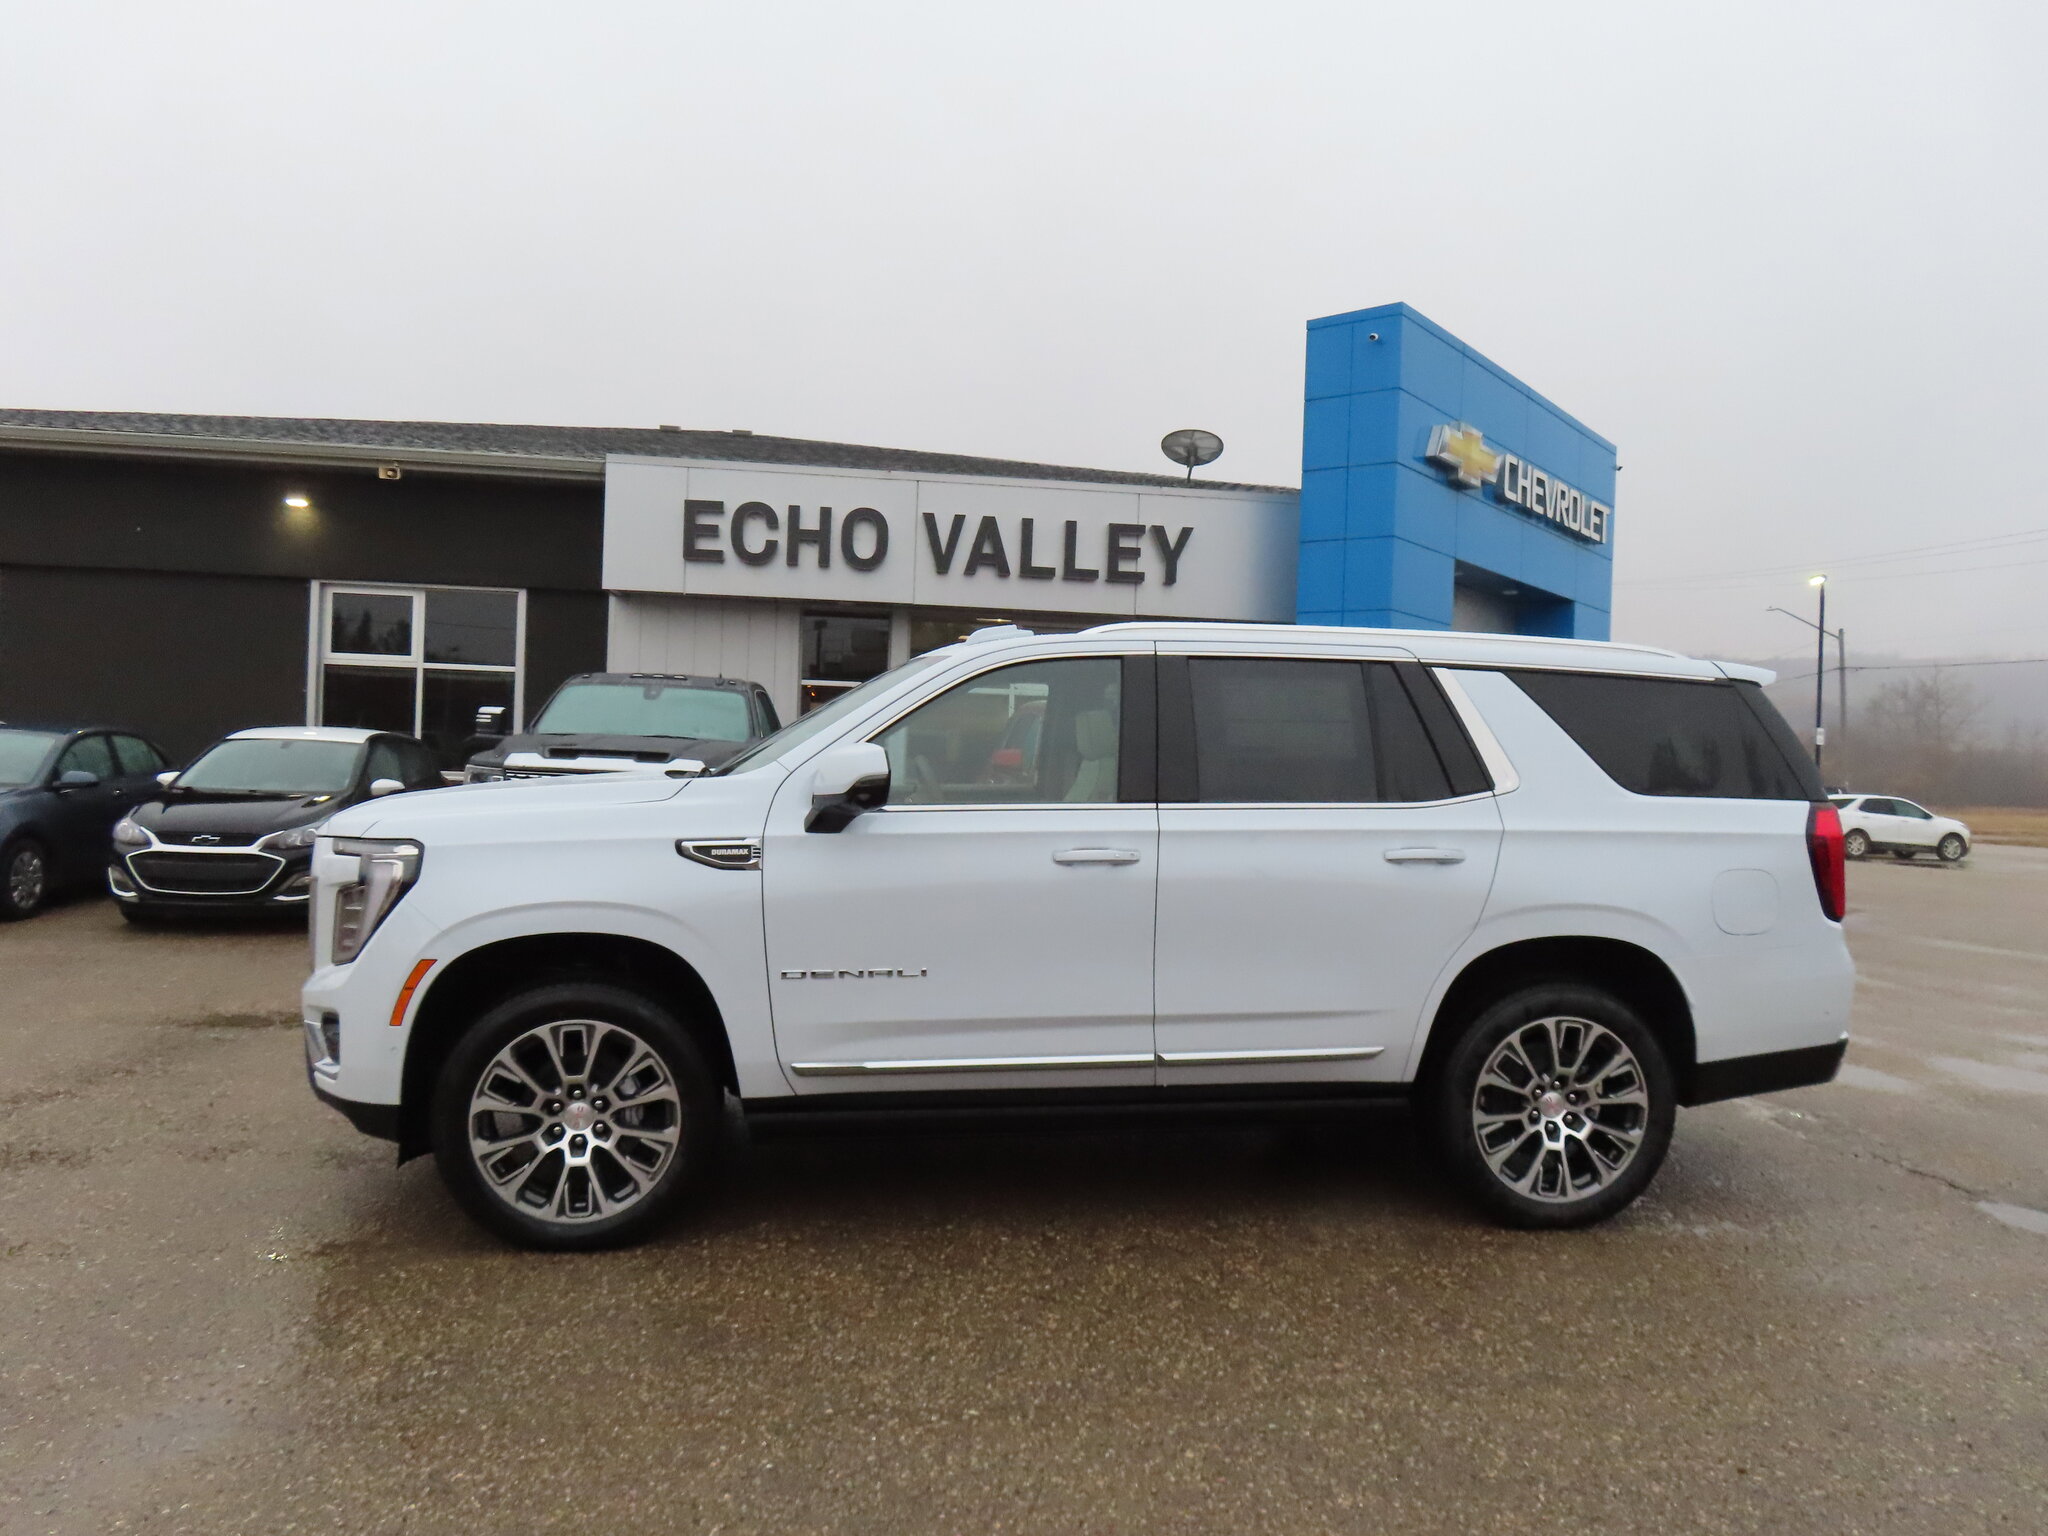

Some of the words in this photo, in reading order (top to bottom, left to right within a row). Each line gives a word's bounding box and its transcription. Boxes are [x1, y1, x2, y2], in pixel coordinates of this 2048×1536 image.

[1504, 453, 1610, 544] CHEVROLET
[683, 499, 889, 571] ECHO
[922, 512, 1194, 586] VALLEY
[711, 848, 749, 856] DURAMAX
[781, 969, 927, 980] DENALI
